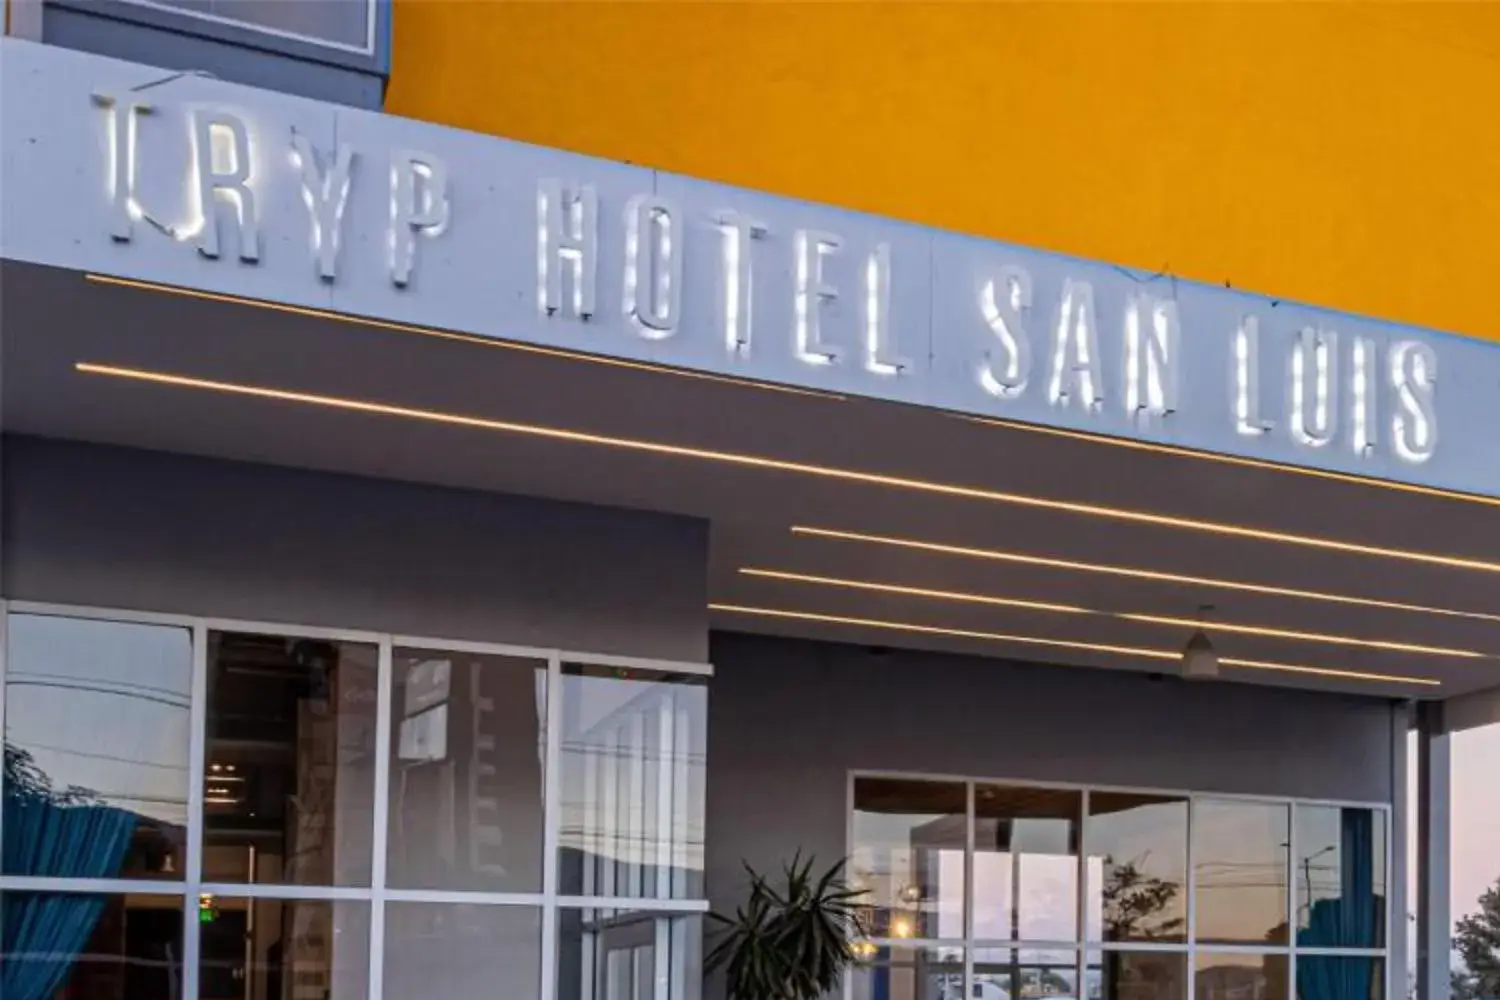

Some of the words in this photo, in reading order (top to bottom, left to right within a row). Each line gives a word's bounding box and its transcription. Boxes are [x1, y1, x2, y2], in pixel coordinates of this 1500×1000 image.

[92, 92, 450, 290] TRYP
[536, 177, 914, 376] HOTEL
[976, 264, 1182, 421] SAN
[1234, 313, 1440, 463] LUIS
